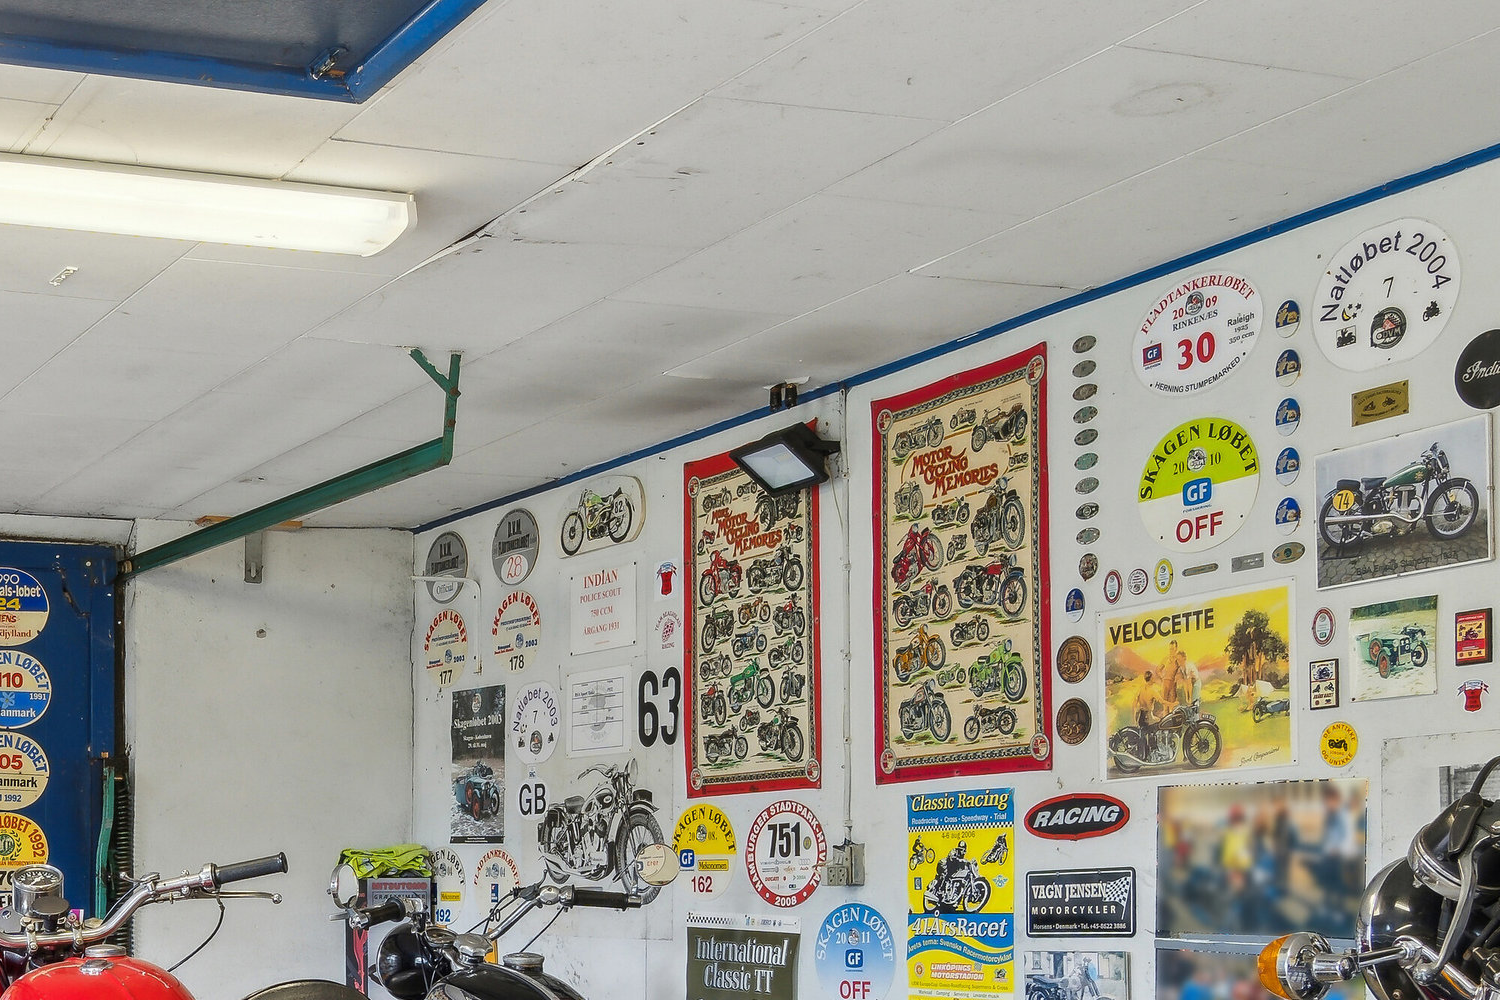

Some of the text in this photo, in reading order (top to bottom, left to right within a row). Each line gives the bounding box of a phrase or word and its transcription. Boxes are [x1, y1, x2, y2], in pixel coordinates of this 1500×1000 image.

[1321, 230, 1452, 323] Natløbet 2004
[1176, 331, 1215, 371] 30
[932, 463, 998, 499] MEMORIES
[1175, 511, 1224, 544] OFF
[506, 556, 523, 578] 28
[584, 570, 618, 588] INDIAN
[1109, 607, 1214, 646] VELOCETTE
[509, 654, 524, 672] 178
[439, 670, 452, 684] 177
[638, 666, 681, 748] 63
[487, 714, 502, 726] 2003
[519, 783, 546, 816] GB
[911, 791, 1009, 812] Classic Racing
[1033, 806, 1120, 828] RACING
[768, 822, 801, 858] 751
[691, 876, 713, 893] 162
[1065, 881, 1106, 902] JENSEN
[435, 909, 451, 923] 192
[1031, 905, 1116, 915] MOTORCYKLER
[695, 936, 788, 966] International
[703, 964, 774, 993] Classic TT
[839, 981, 871, 999] OFF
